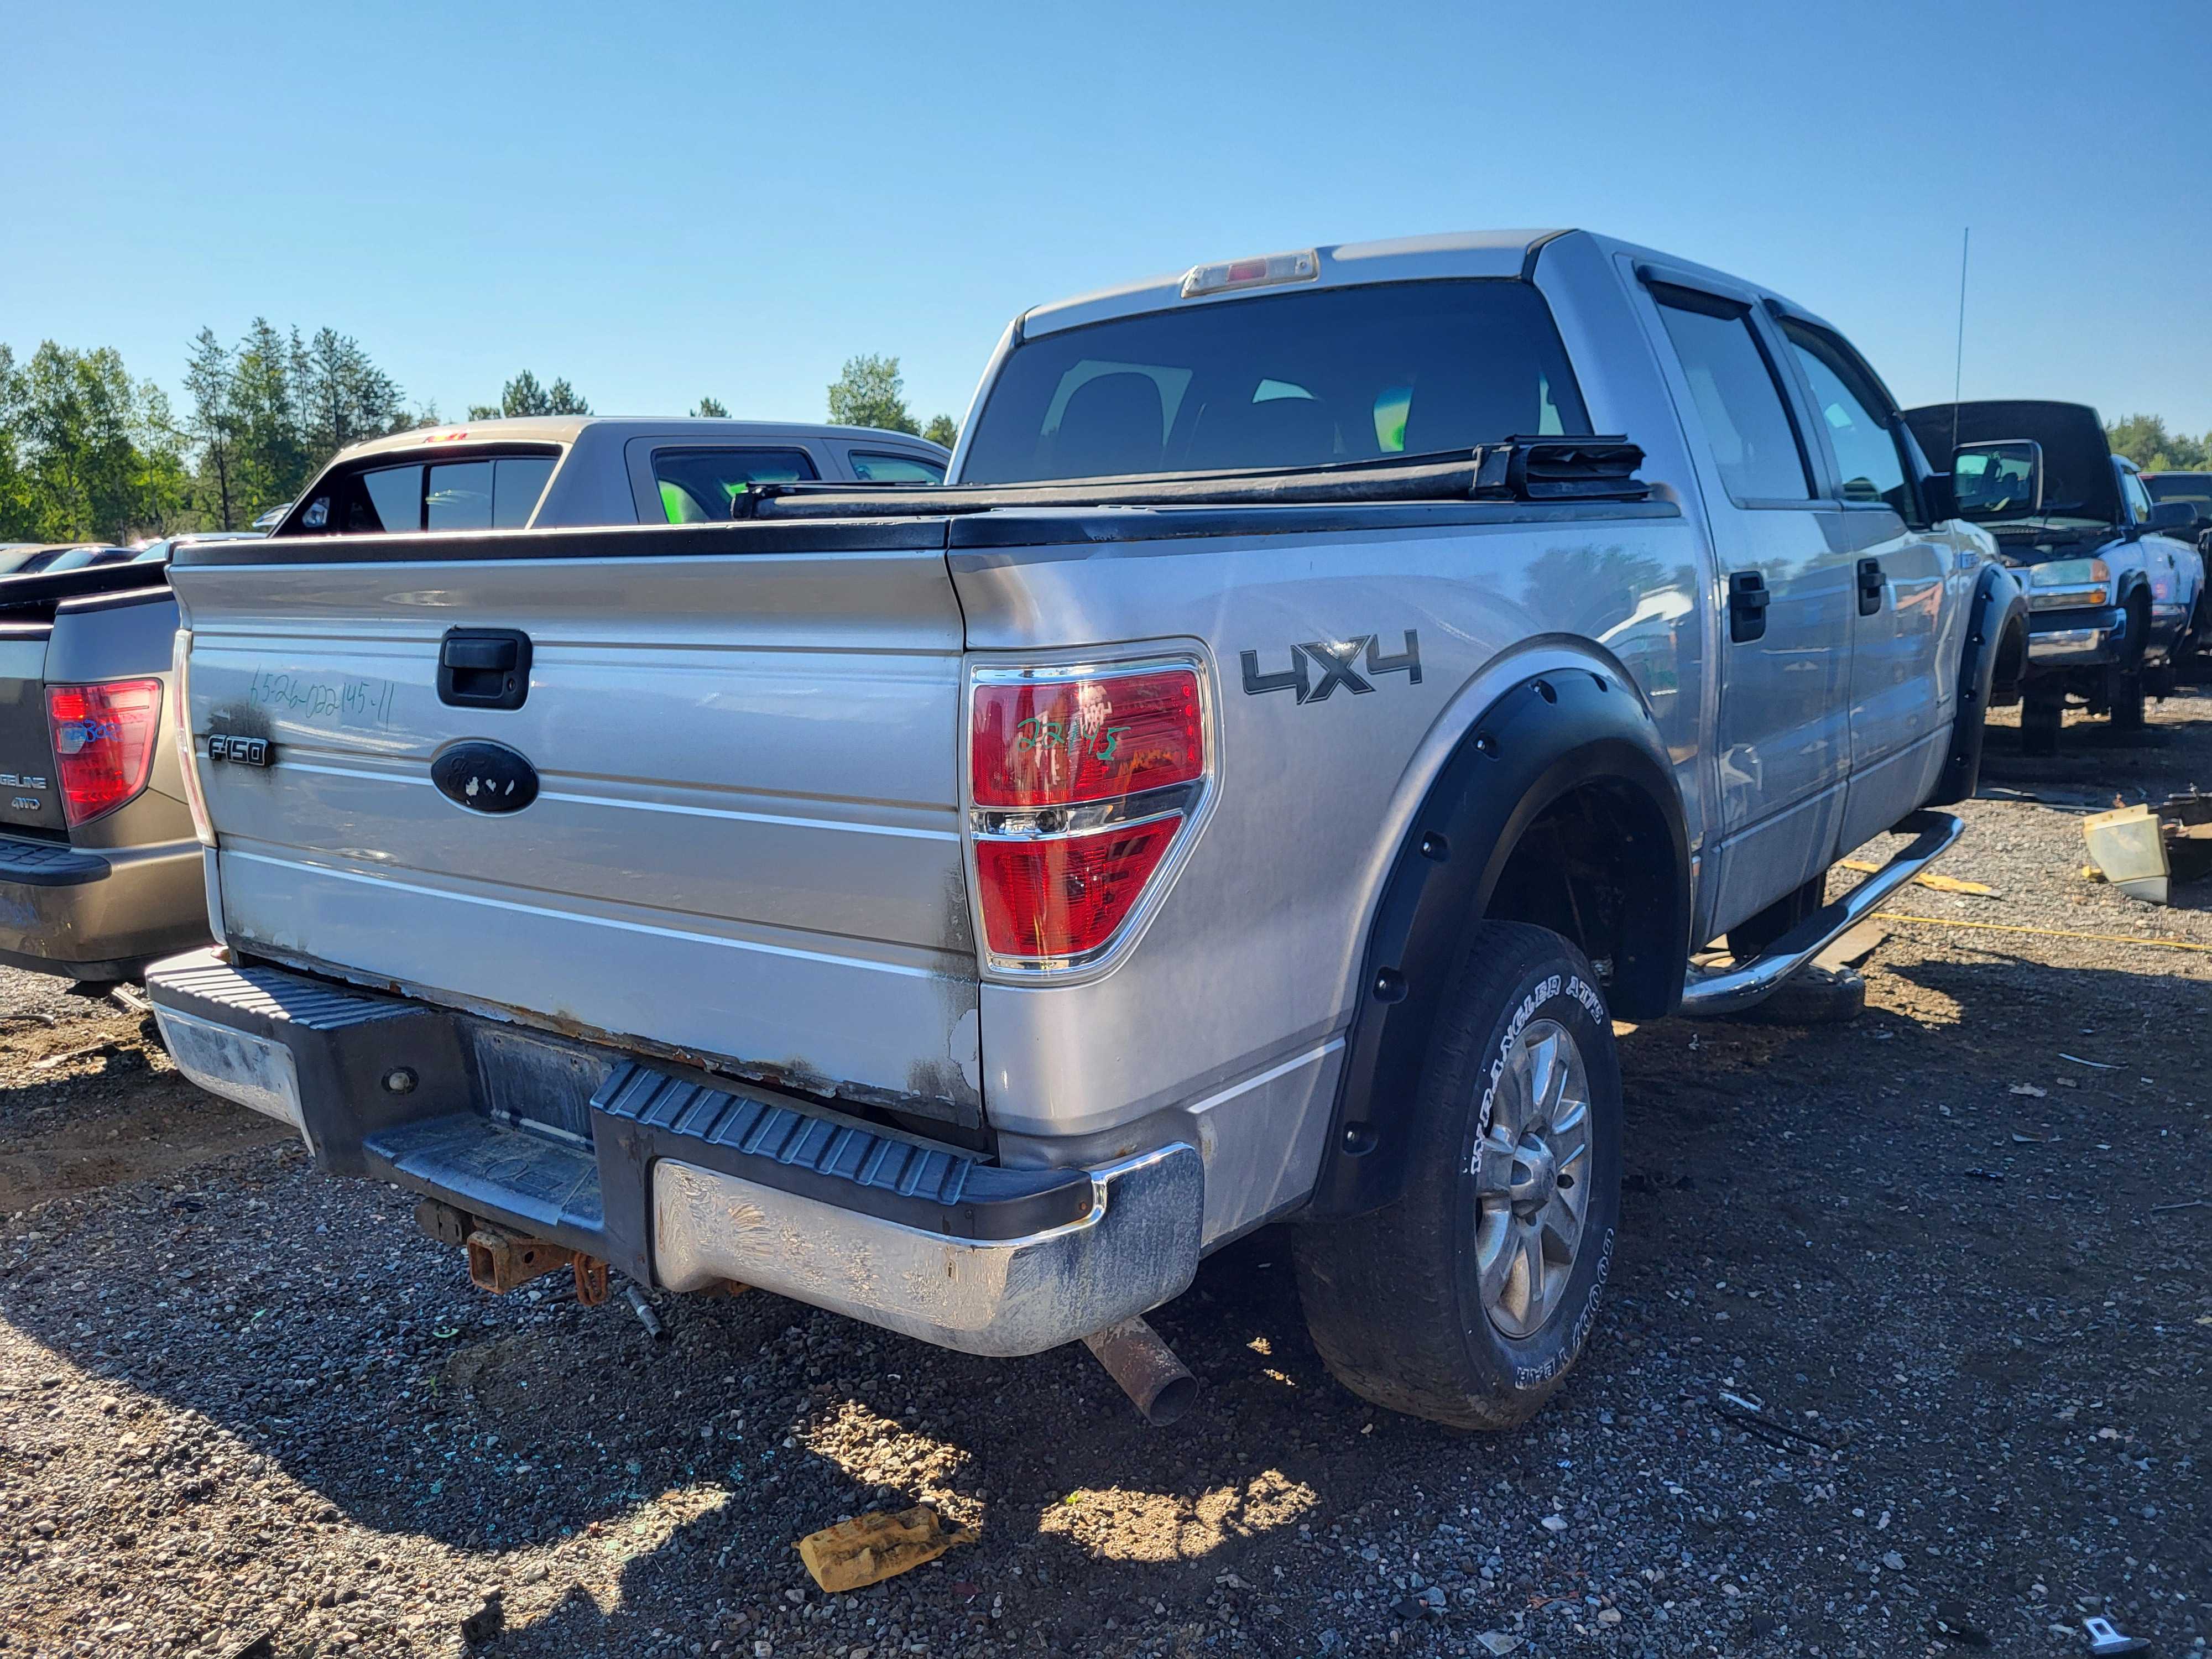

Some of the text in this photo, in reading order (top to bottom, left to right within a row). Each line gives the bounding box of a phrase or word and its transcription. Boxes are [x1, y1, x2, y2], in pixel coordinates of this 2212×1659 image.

[208, 734, 268, 766] F-150
[1017, 718, 1131, 761] 22145
[11, 797, 40, 810] 4WD
[1470, 974, 1562, 1175] WRANGLER
